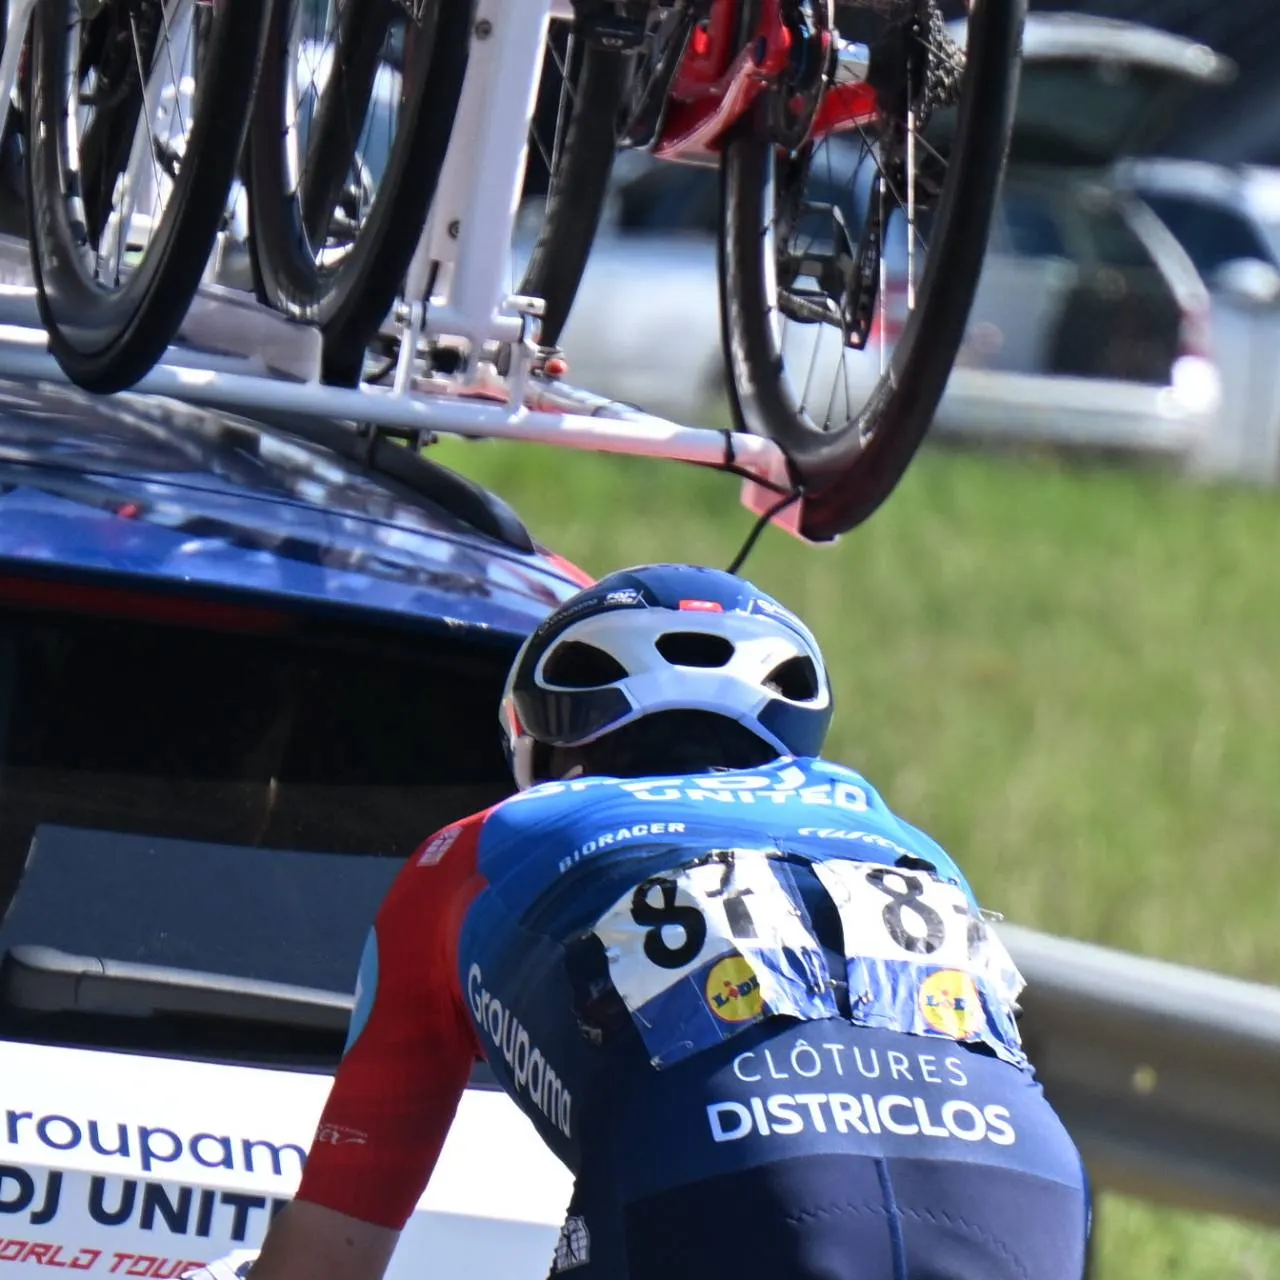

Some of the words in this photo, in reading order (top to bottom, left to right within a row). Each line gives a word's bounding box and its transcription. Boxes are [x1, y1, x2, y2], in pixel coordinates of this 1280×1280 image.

[632, 783, 869, 812] UNITED
[558, 822, 686, 874] BIORACER
[712, 976, 760, 1007] LID
[468, 963, 572, 1139] Groupama
[733, 1039, 968, 1086] CLÔTURES
[707, 1093, 1016, 1145] DISTRICLOS
[88, 1175, 296, 1242] UNIT
